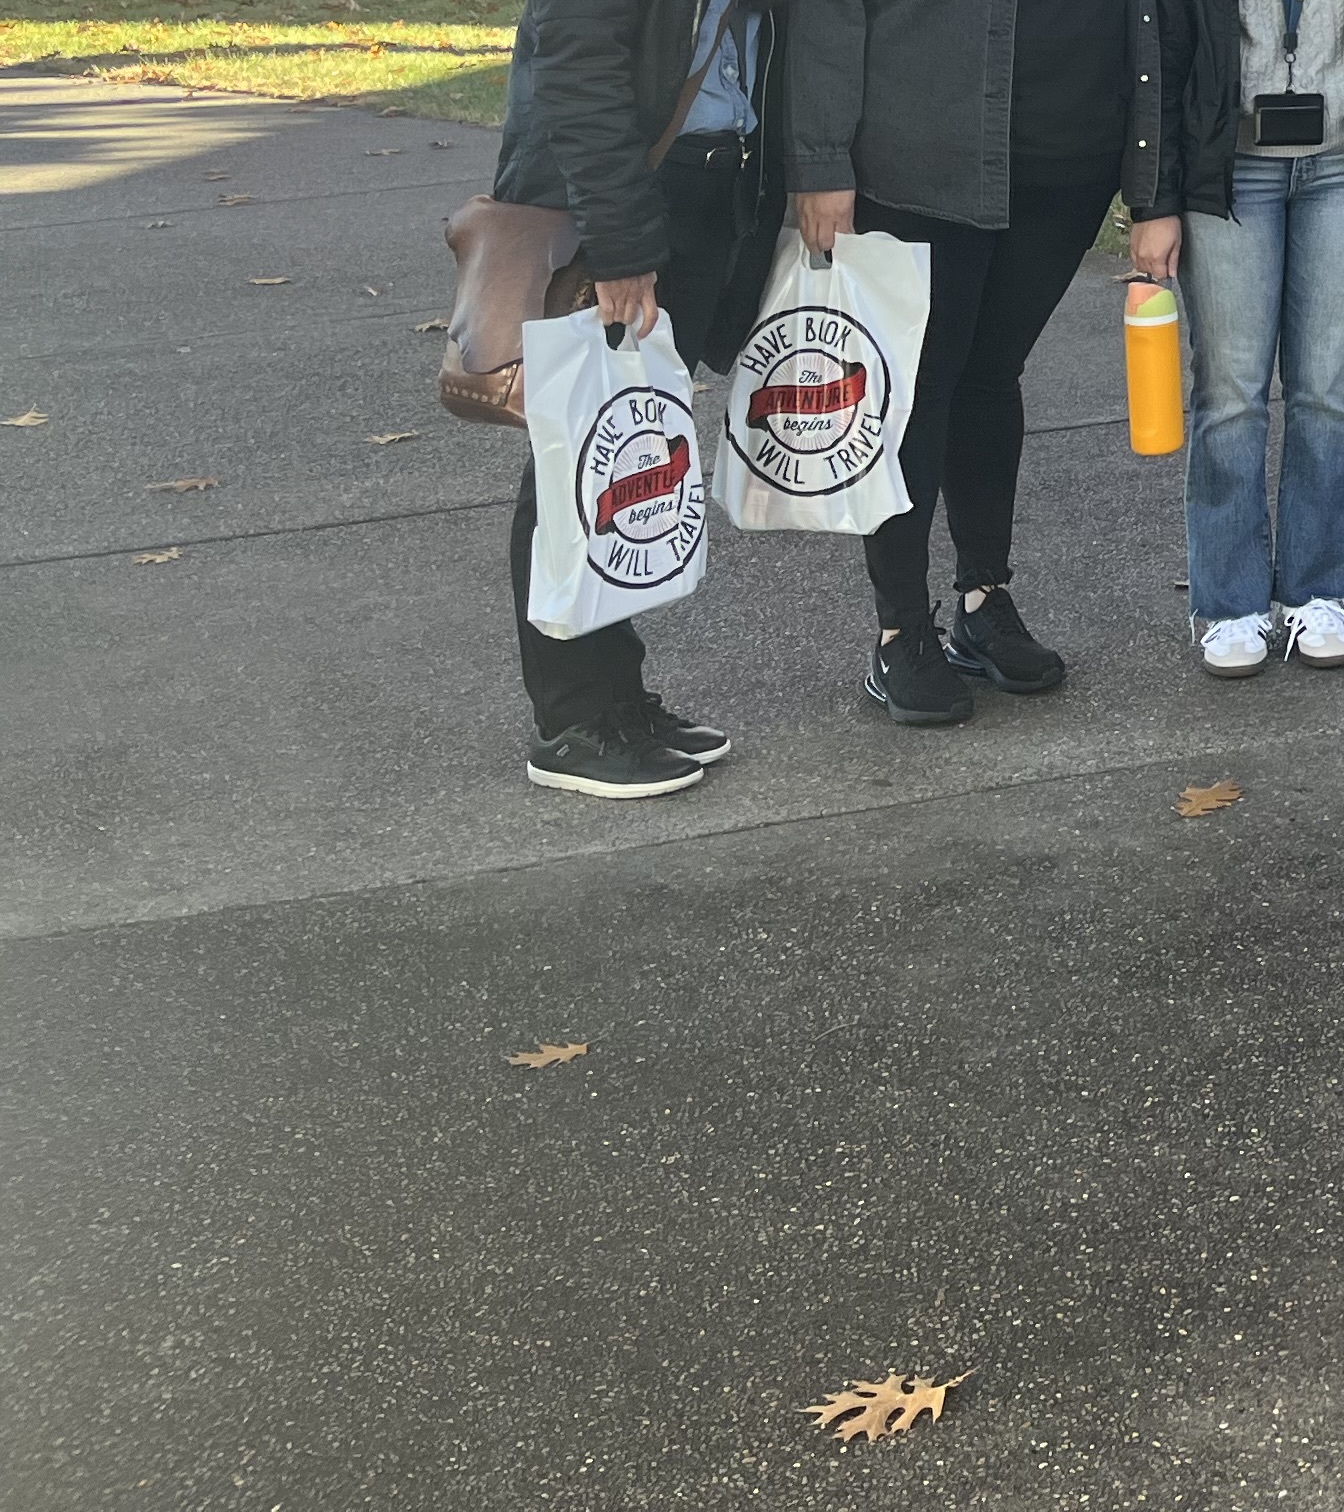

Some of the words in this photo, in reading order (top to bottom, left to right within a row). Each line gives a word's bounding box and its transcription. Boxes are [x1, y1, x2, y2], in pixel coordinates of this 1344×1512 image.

[740, 323, 793, 376] HAVE
[798, 370, 823, 384] The
[766, 385, 850, 410] ADVENTURE
[783, 417, 833, 437] begins
[756, 438, 805, 484] WILL
[823, 413, 882, 480] TRAVEL
[638, 454, 660, 470] The
[628, 499, 676, 525] begins
[608, 540, 654, 576] WILL
